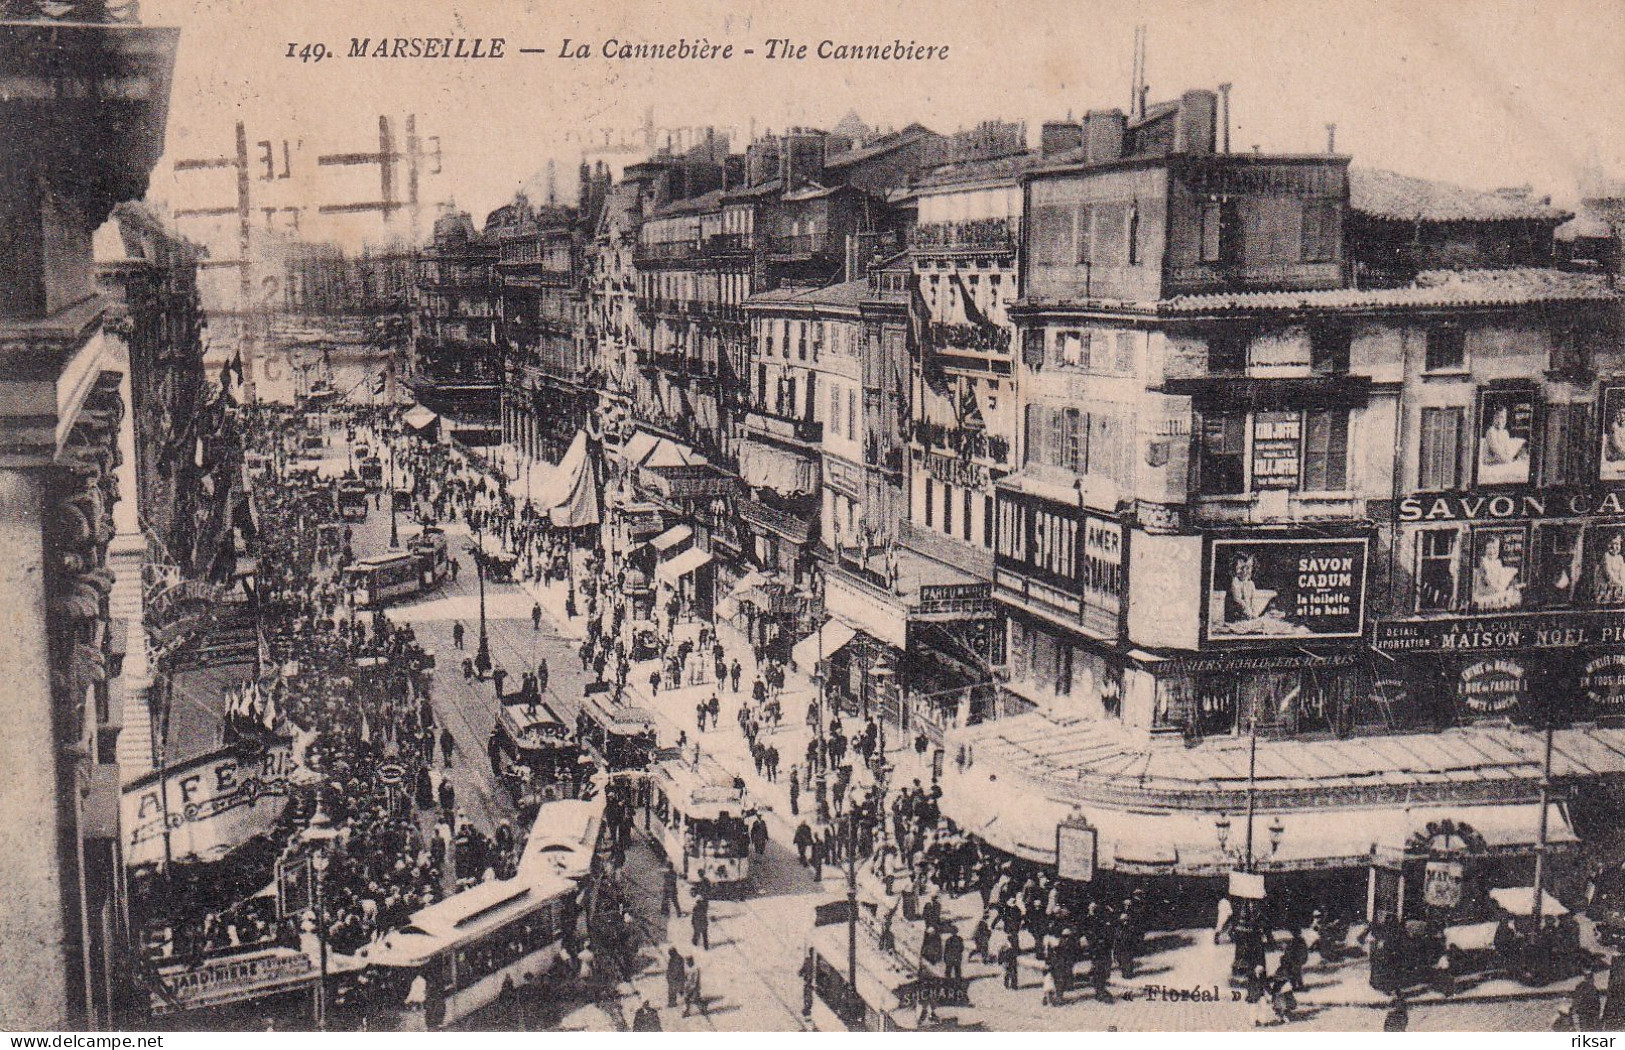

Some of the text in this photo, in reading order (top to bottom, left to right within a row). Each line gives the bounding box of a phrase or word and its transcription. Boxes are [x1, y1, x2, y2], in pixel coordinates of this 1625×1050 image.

[1399, 496, 1546, 521] SAVON
[1298, 557, 1352, 571] SAVON
[1298, 573, 1351, 588] CADUM
[1296, 593, 1350, 604] la toilette
[1324, 604, 1350, 616] bain
[1441, 631, 1521, 649] MAISON
[138, 763, 237, 819] AFE
